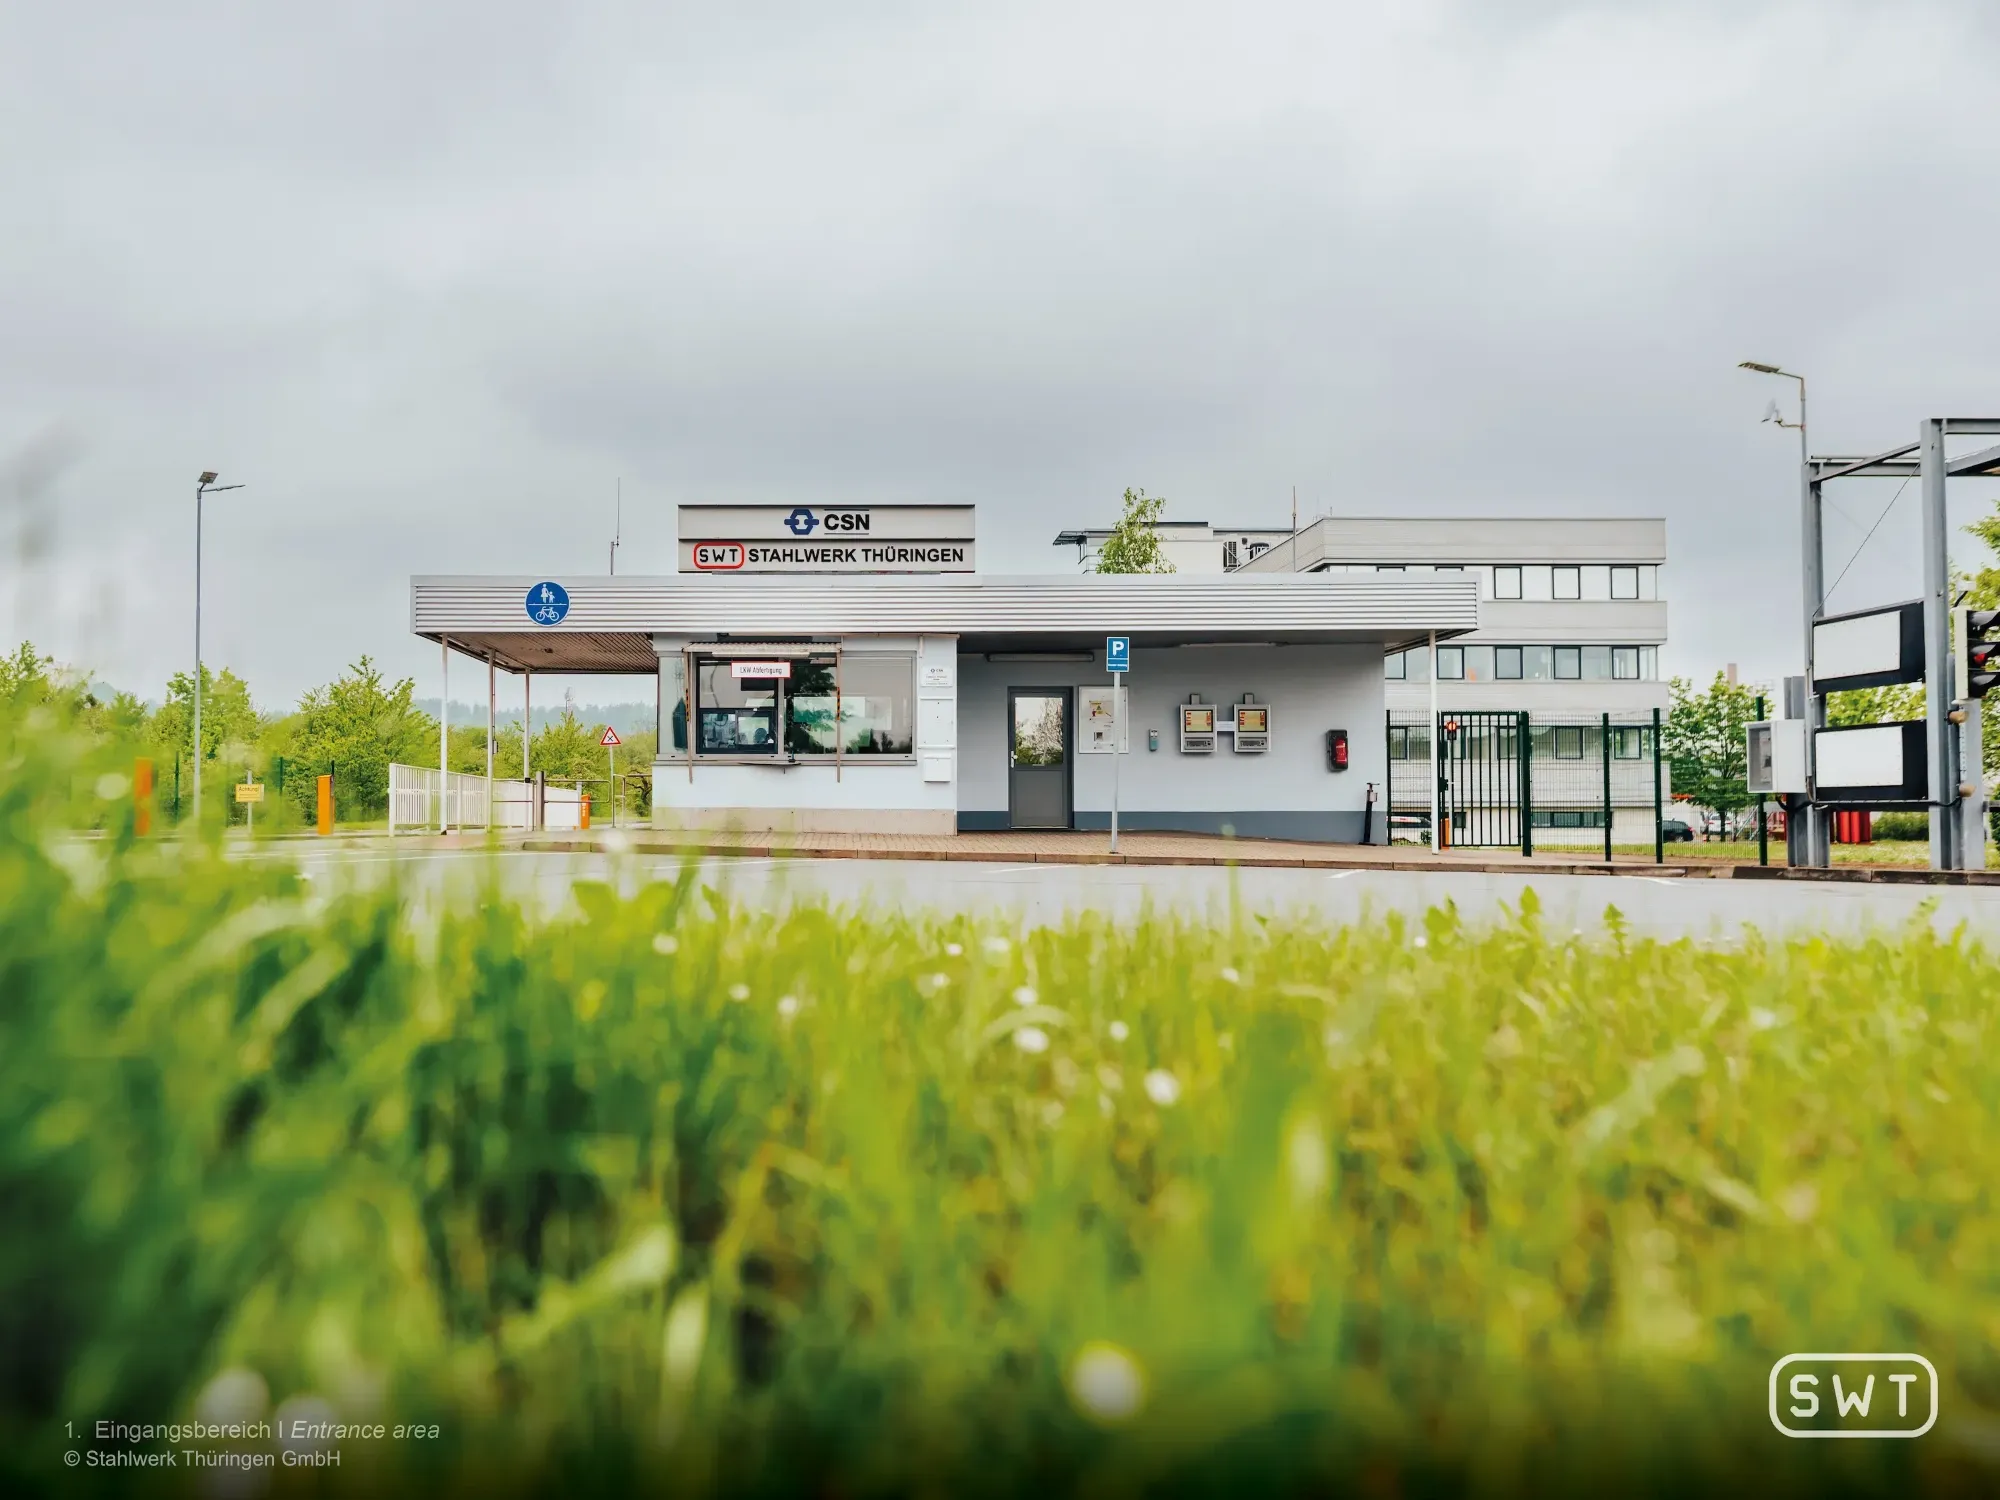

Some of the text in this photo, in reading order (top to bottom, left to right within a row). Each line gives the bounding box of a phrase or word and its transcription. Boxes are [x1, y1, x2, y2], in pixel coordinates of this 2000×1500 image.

[824, 513, 870, 531] CSN
[699, 545, 964, 562] SWT STAHLWERK THÜRINGEN
[1112, 641, 1124, 656] P
